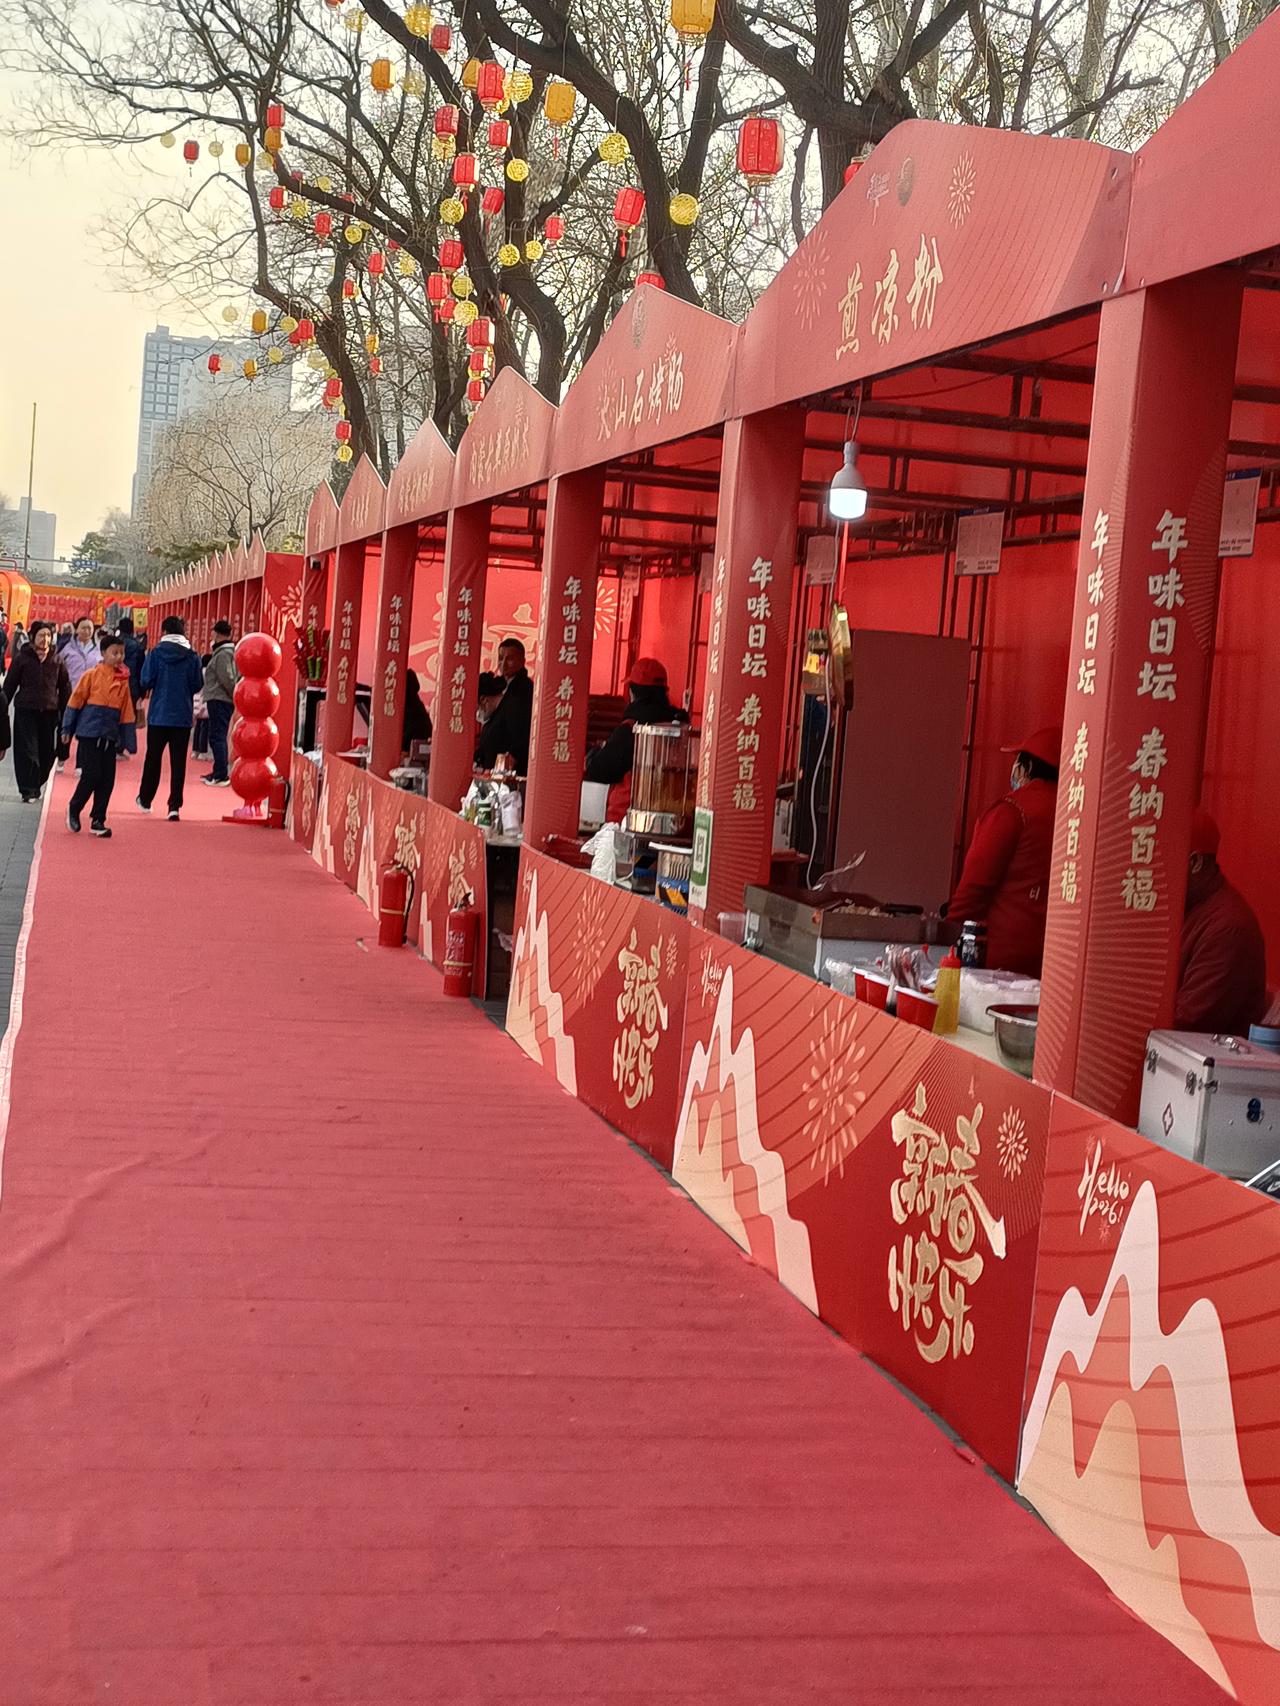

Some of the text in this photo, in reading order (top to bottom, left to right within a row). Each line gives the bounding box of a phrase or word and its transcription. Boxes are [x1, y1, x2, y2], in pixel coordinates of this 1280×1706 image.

[836, 233, 944, 361] 煎凉粉
[597, 351, 684, 441] 火山石烤肠
[339, 600, 353, 650] 年味日坛
[384, 594, 402, 717] 年味日坛 春纳百福
[449, 586, 472, 733] 年味日坛 春纳百福
[552, 576, 582, 762] 年味日坛 春纳百福
[709, 555, 726, 675] 年味日坛
[732, 556, 773, 811] 年味日坛 春纳百福
[1060, 509, 1110, 905] 年味日坛 春纳百福
[1120, 509, 1188, 912] 年味日坛 春纳百福
[701, 947, 722, 1008] Hello
[1078, 1139, 1129, 1236] Hello
[1089, 1197, 1123, 1224] 2026!
